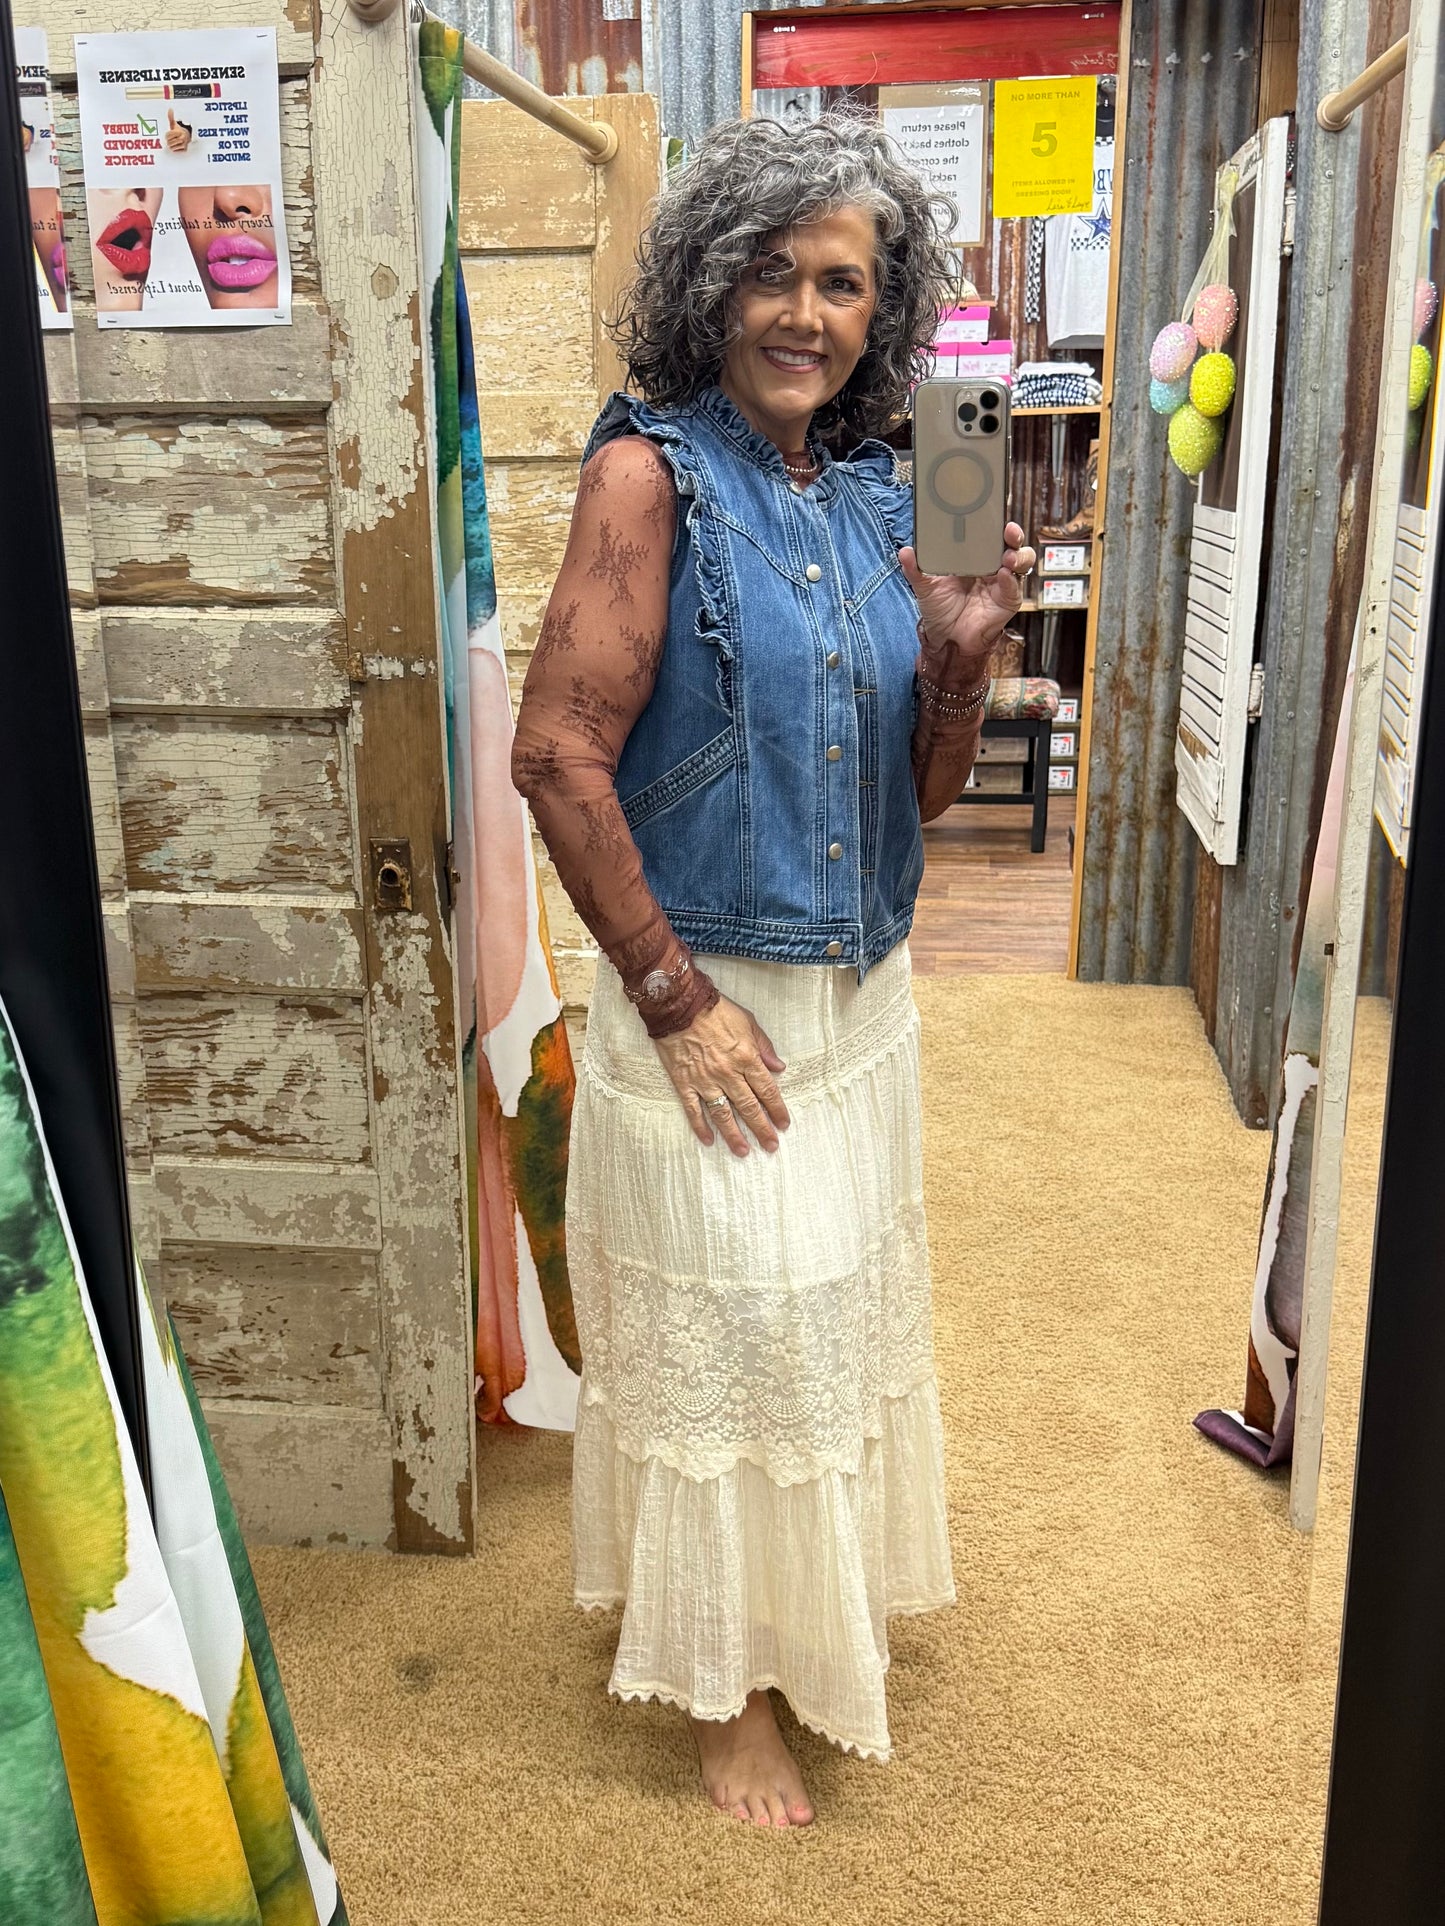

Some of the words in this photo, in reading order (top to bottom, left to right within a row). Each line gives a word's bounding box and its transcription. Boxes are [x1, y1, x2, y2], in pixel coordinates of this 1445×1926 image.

[1027, 92, 1053, 100] MORE
[1055, 90, 1080, 99] THAN
[1031, 122, 1058, 157] 5
